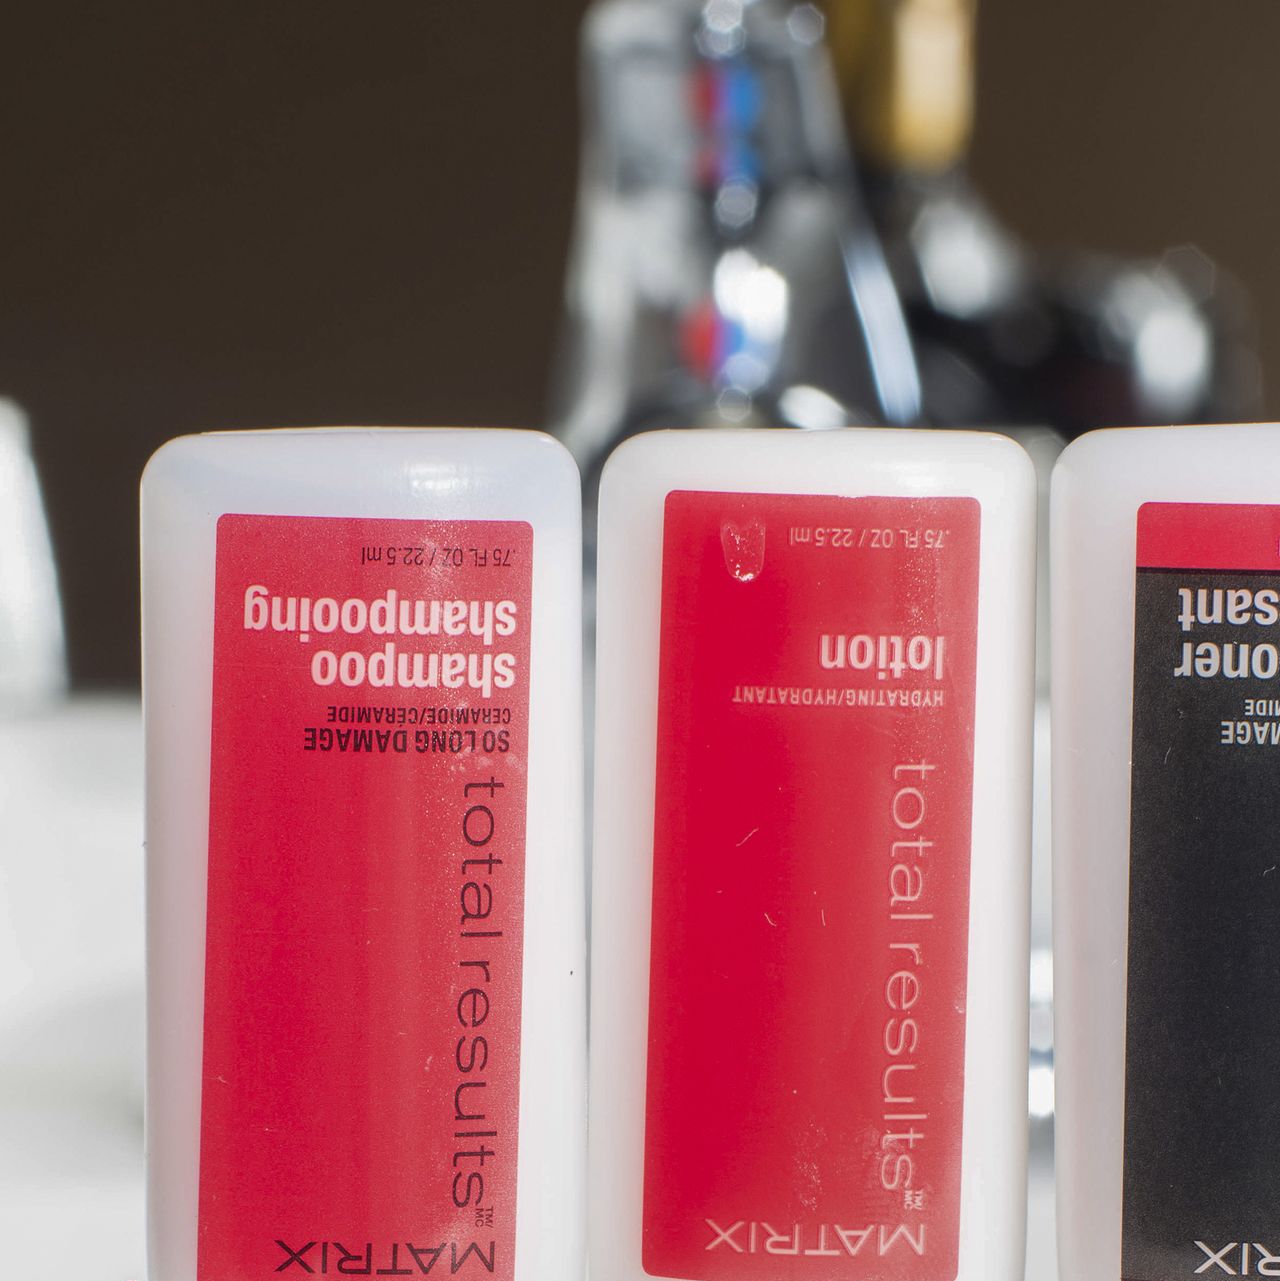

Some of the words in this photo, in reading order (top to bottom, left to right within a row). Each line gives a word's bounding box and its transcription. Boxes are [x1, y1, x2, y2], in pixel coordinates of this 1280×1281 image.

[790, 526, 810, 546] ml
[815, 526, 853, 548] 22.5
[871, 527, 894, 548] OZ
[900, 527, 920, 548] FL
[924, 528, 950, 549] .75
[361, 546, 384, 566] ml
[386, 546, 425, 567] 22.5
[469, 548, 488, 567] FL
[491, 547, 516, 568] .75
[243, 585, 517, 645] shampooing
[820, 634, 945, 680] lotion
[310, 642, 516, 698] shampoo
[732, 685, 944, 707] HYDRATING/HYDRATANT
[303, 727, 408, 752] DAMAGE
[415, 729, 476, 753] LONG
[482, 730, 510, 753] SO
[888, 758, 936, 920] total
[460, 775, 506, 939] total
[880, 942, 928, 1192] results
[451, 960, 498, 1209] results
[704, 1218, 926, 1256] MATRIX
[273, 1240, 496, 1275] MATRIX
